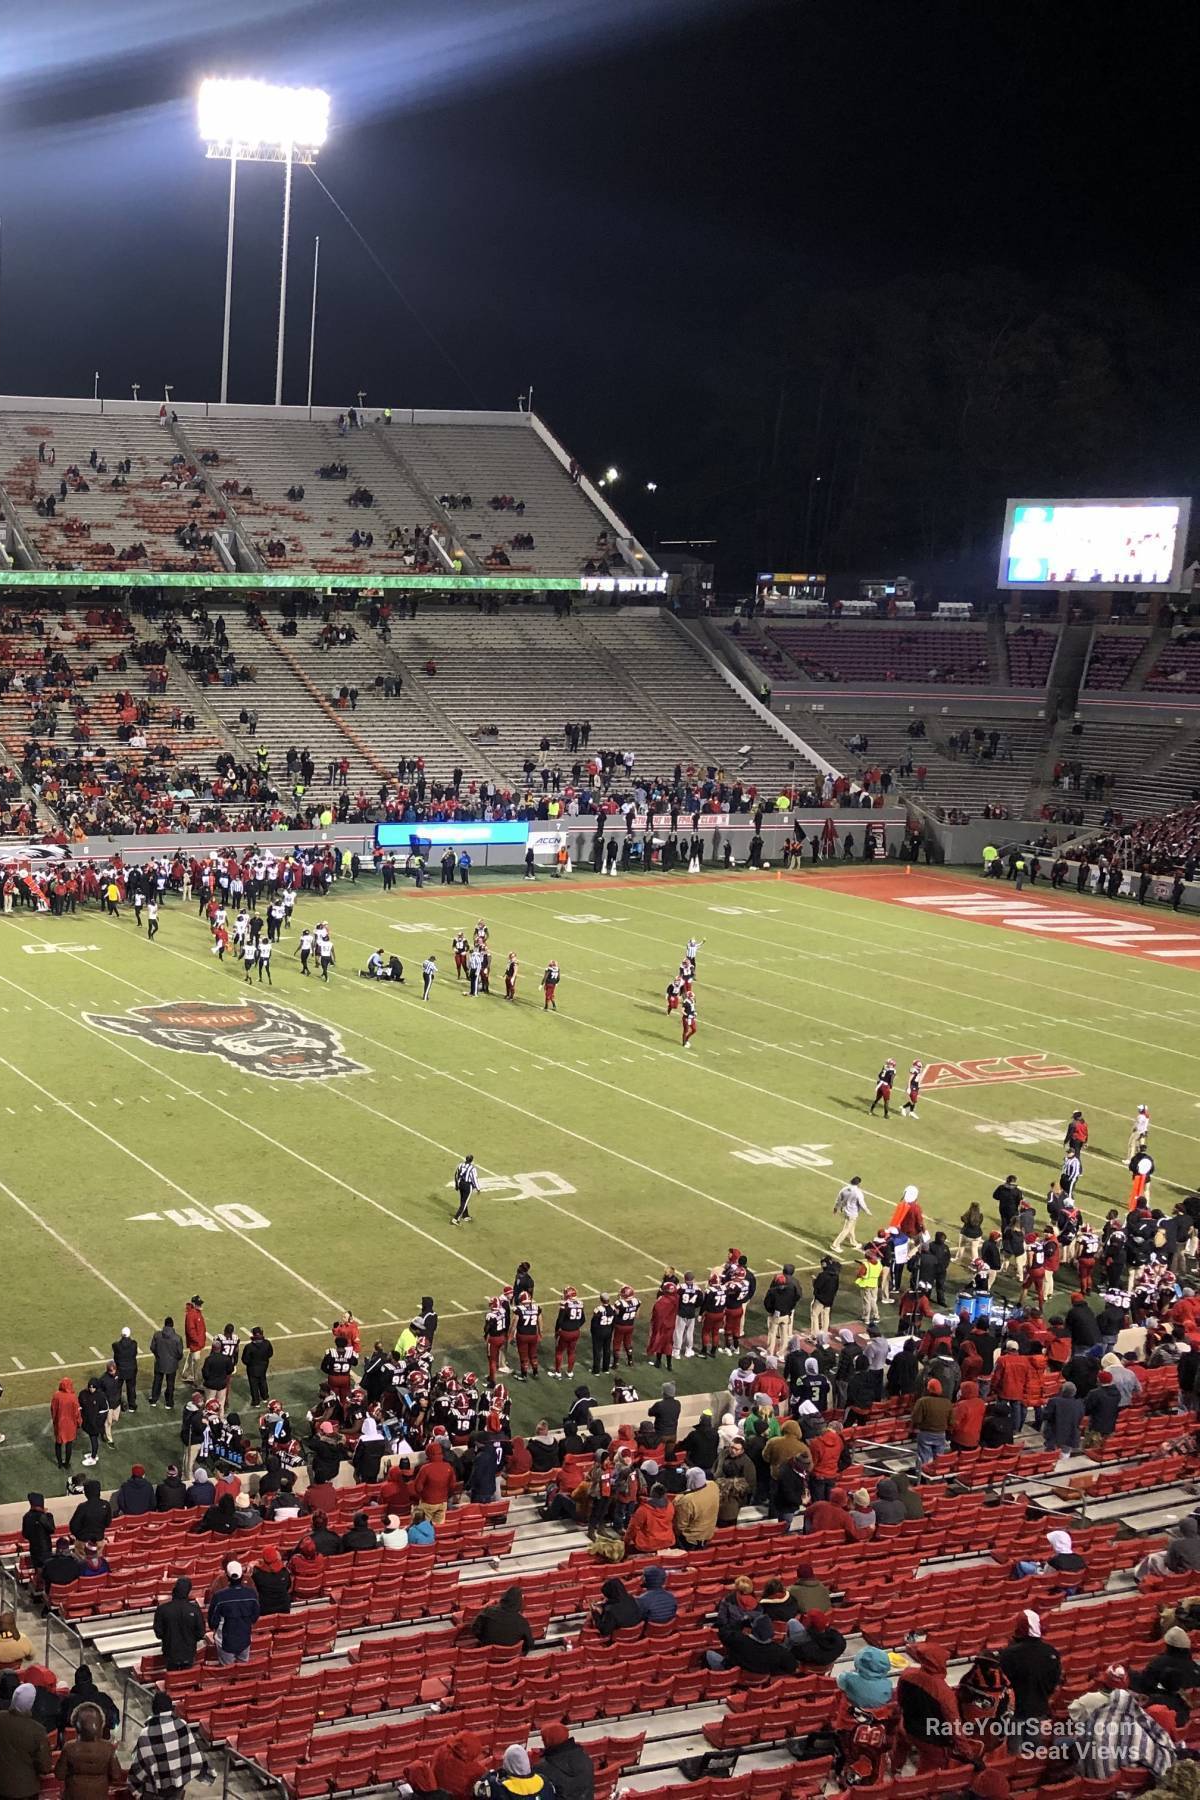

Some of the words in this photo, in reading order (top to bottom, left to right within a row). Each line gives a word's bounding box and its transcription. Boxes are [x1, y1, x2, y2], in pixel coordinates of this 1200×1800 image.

[891, 893, 1200, 958] WOL
[22, 942, 103, 954] 50
[168, 1014, 195, 1025] NC
[198, 1012, 251, 1026] STATE
[916, 1053, 1080, 1088] ACC
[729, 1145, 834, 1169] 40
[446, 1171, 577, 1201] 50
[163, 1203, 272, 1232] 40
[523, 1314, 538, 1326] 72
[569, 1308, 582, 1320] 93
[222, 1345, 235, 1356] 31
[811, 1386, 821, 1401] 3
